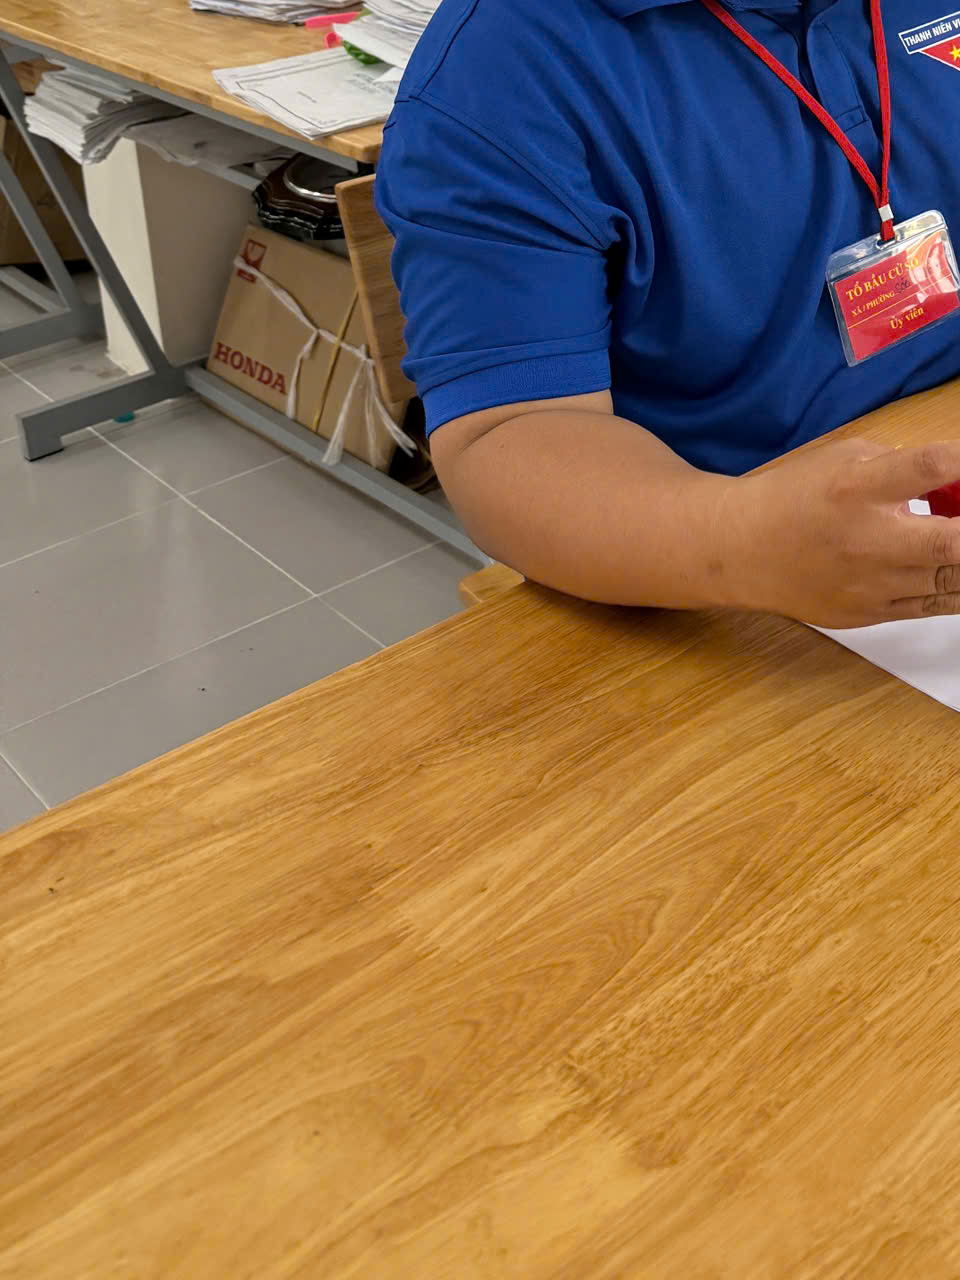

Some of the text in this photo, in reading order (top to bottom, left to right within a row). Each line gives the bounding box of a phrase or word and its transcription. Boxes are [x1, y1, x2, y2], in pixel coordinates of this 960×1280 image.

[903, 29, 933, 47] THANH
[931, 21, 953, 37] NIÊN
[845, 281, 863, 301] TỔ
[905, 306, 924, 321] viên
[213, 341, 288, 396] HONDA
